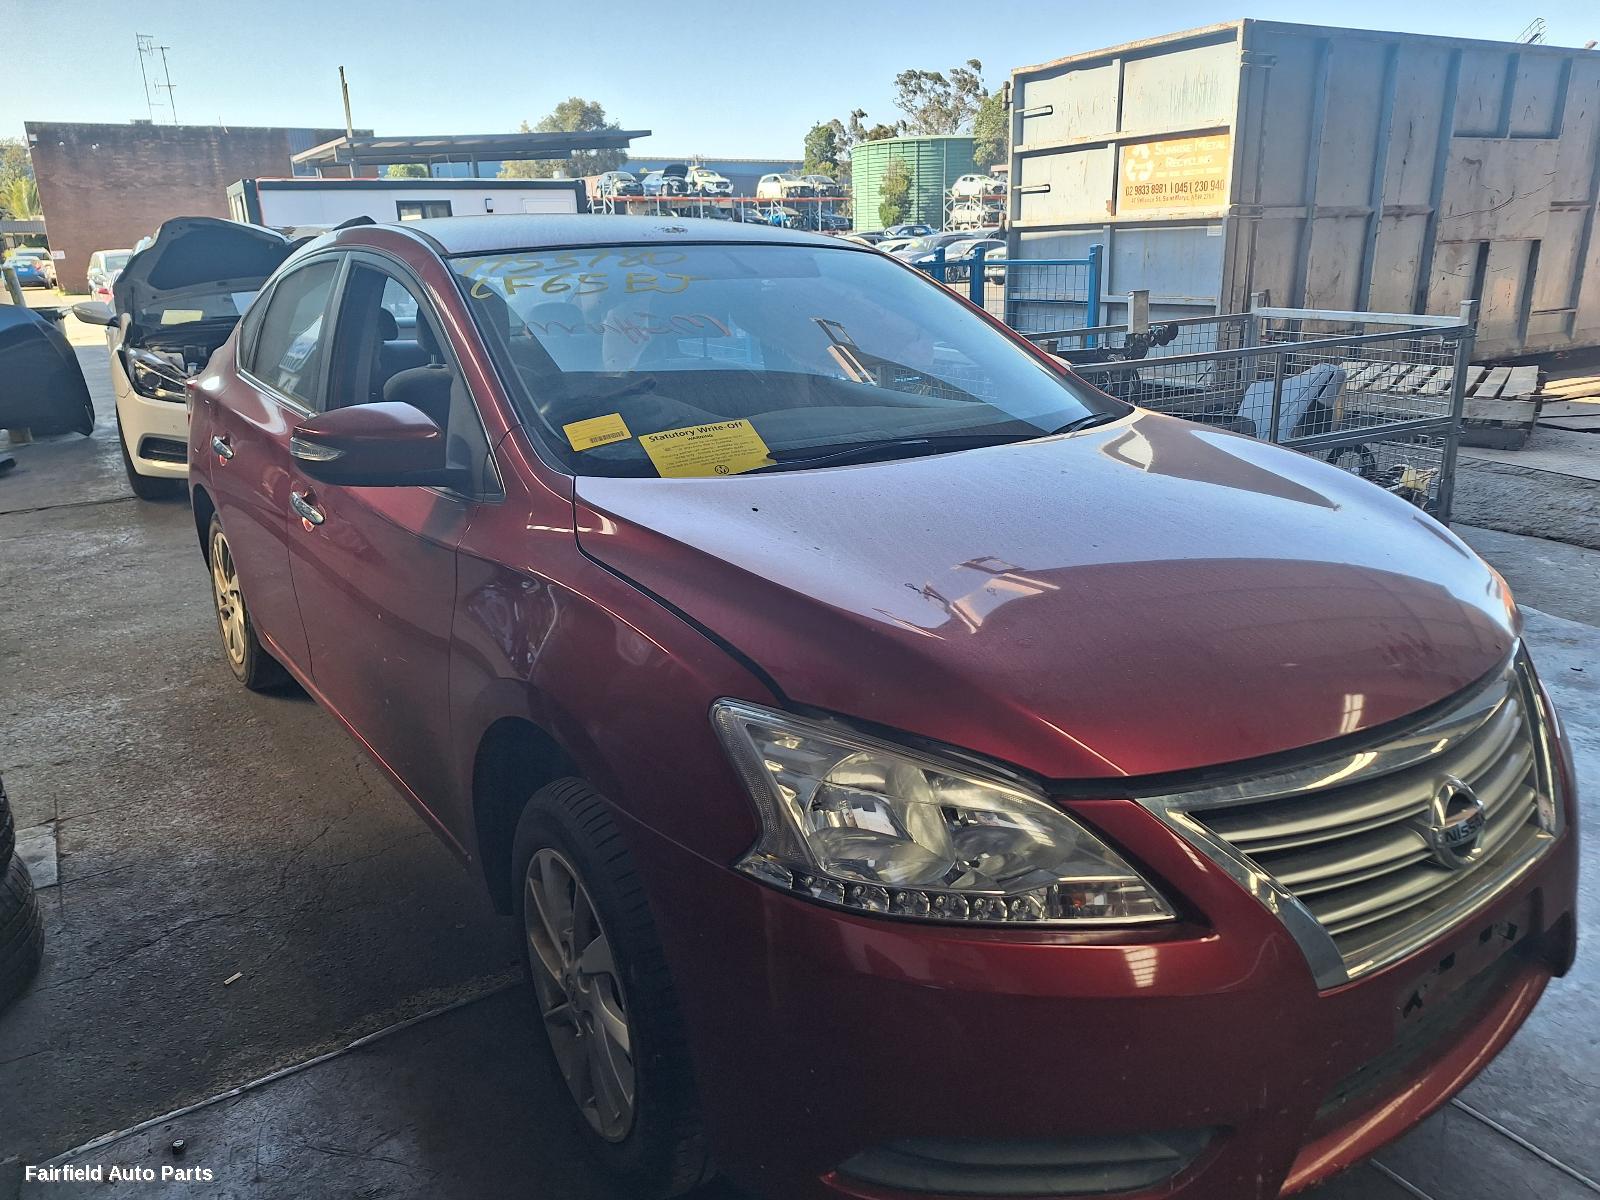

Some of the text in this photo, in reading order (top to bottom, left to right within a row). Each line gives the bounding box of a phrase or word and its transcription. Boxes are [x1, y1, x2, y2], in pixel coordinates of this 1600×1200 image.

[1125, 185, 1134, 196] 02
[1134, 184, 1150, 196] 9833
[1151, 183, 1167, 194] 8981
[1174, 182, 1193, 194] 0451
[1194, 180, 1209, 192] 230
[1210, 179, 1225, 191] 940
[648, 421, 743, 443] Statutory Write-Off
[687, 433, 714, 441] WARNING
